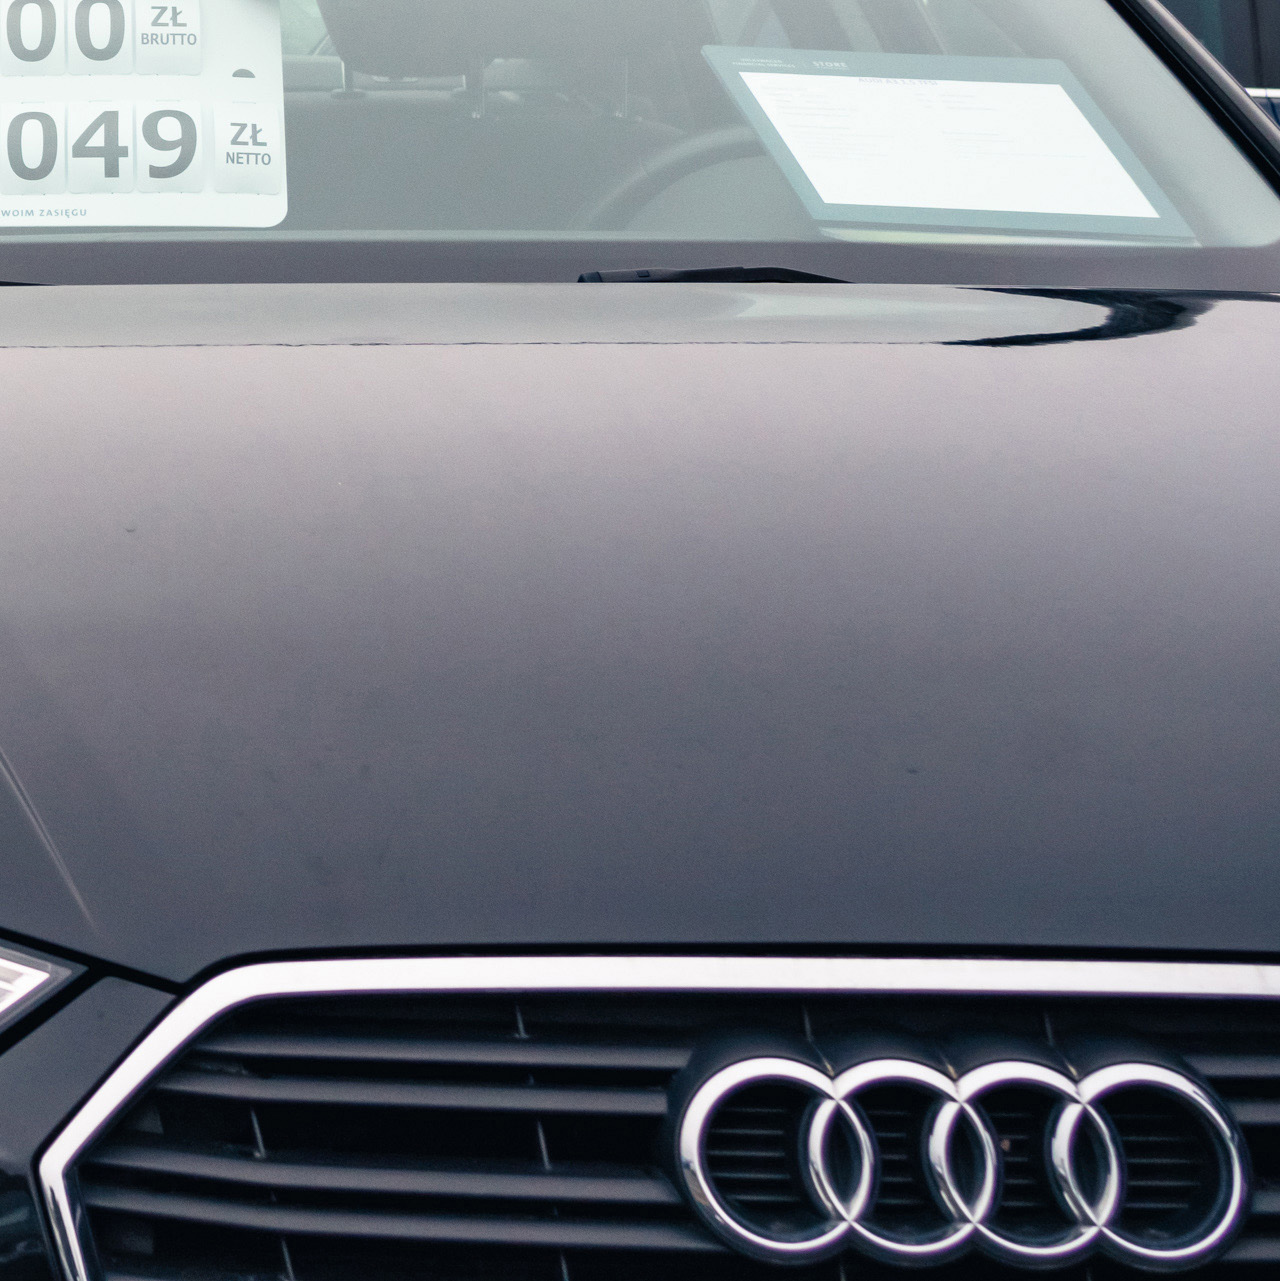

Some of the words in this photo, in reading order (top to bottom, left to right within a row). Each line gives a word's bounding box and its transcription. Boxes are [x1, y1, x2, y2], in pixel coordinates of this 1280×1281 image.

[150, 5, 188, 28] ZŁ
[140, 32, 198, 46] BRUTTO
[230, 122, 268, 147] ZŁ
[225, 151, 272, 166] NETTO
[39, 208, 88, 219] ZASIĘGU
